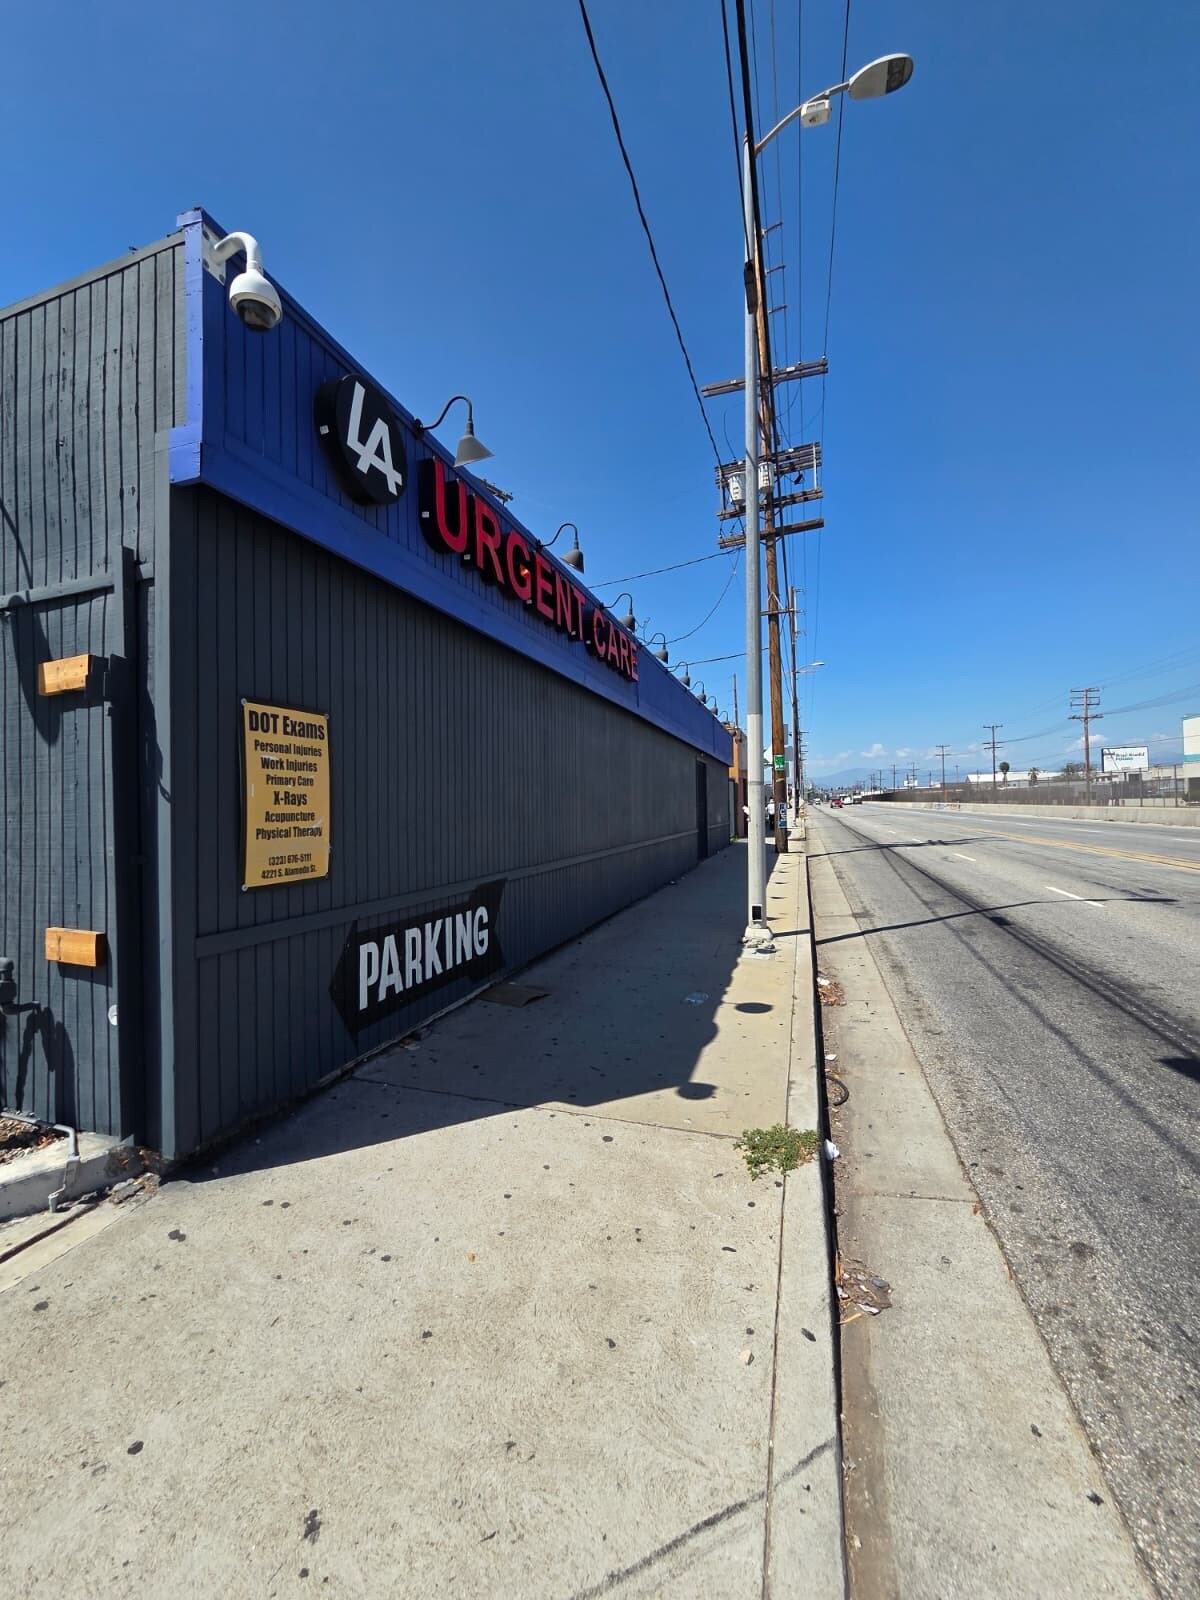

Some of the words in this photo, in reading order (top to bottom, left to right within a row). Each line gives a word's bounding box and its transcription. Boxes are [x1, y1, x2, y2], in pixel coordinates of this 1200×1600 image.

[346, 381, 402, 496] LA
[431, 455, 586, 641] URGENT
[591, 607, 639, 682] CARE
[248, 709, 279, 735] DOT
[282, 716, 325, 740] Exams
[254, 739, 292, 754] Personal
[293, 744, 322, 757] Injuries
[261, 757, 285, 770] Work
[286, 759, 318, 772] Injuries
[266, 774, 296, 787] Primary
[297, 776, 314, 786] Care
[273, 790, 308, 806] X-Rays
[265, 811, 316, 823] Acupuncture
[256, 827, 292, 840] Physical
[293, 826, 323, 838] Therapy
[268, 855, 287, 866] (323)
[261, 870, 277, 879] 4221
[284, 866, 310, 876] Alameda
[359, 906, 489, 1011] PARKING
